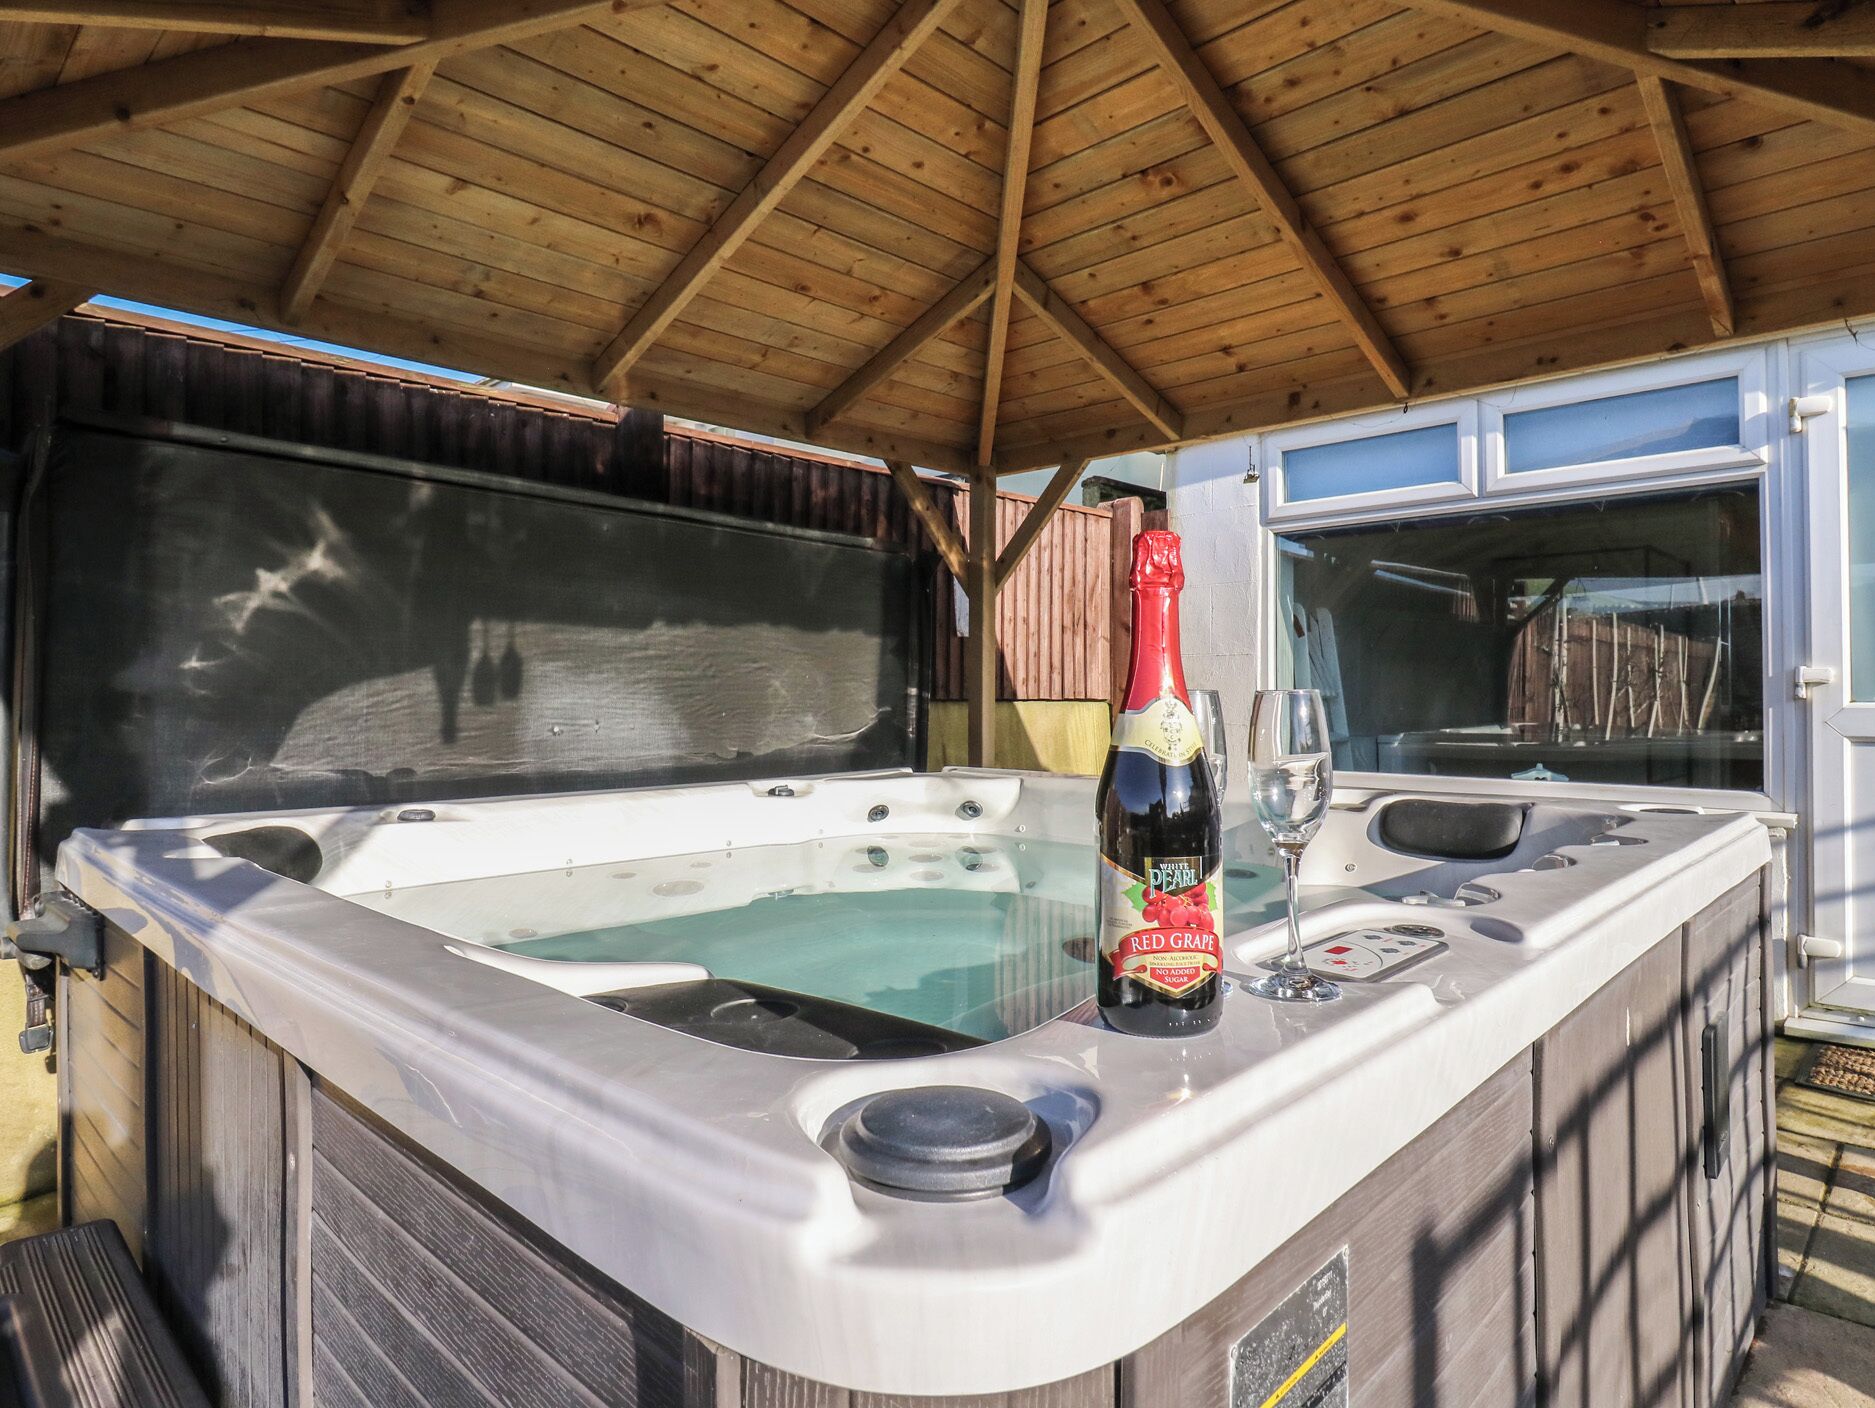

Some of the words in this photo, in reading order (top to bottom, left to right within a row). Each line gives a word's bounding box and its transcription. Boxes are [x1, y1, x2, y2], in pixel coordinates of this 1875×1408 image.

[1159, 862, 1189, 870] WHITE
[1149, 868, 1198, 899] PEARL
[1130, 934, 1165, 953] RED
[1169, 932, 1215, 951] GRAPE
[1170, 967, 1196, 975] ADDED
[1164, 975, 1189, 983] SUGAR
